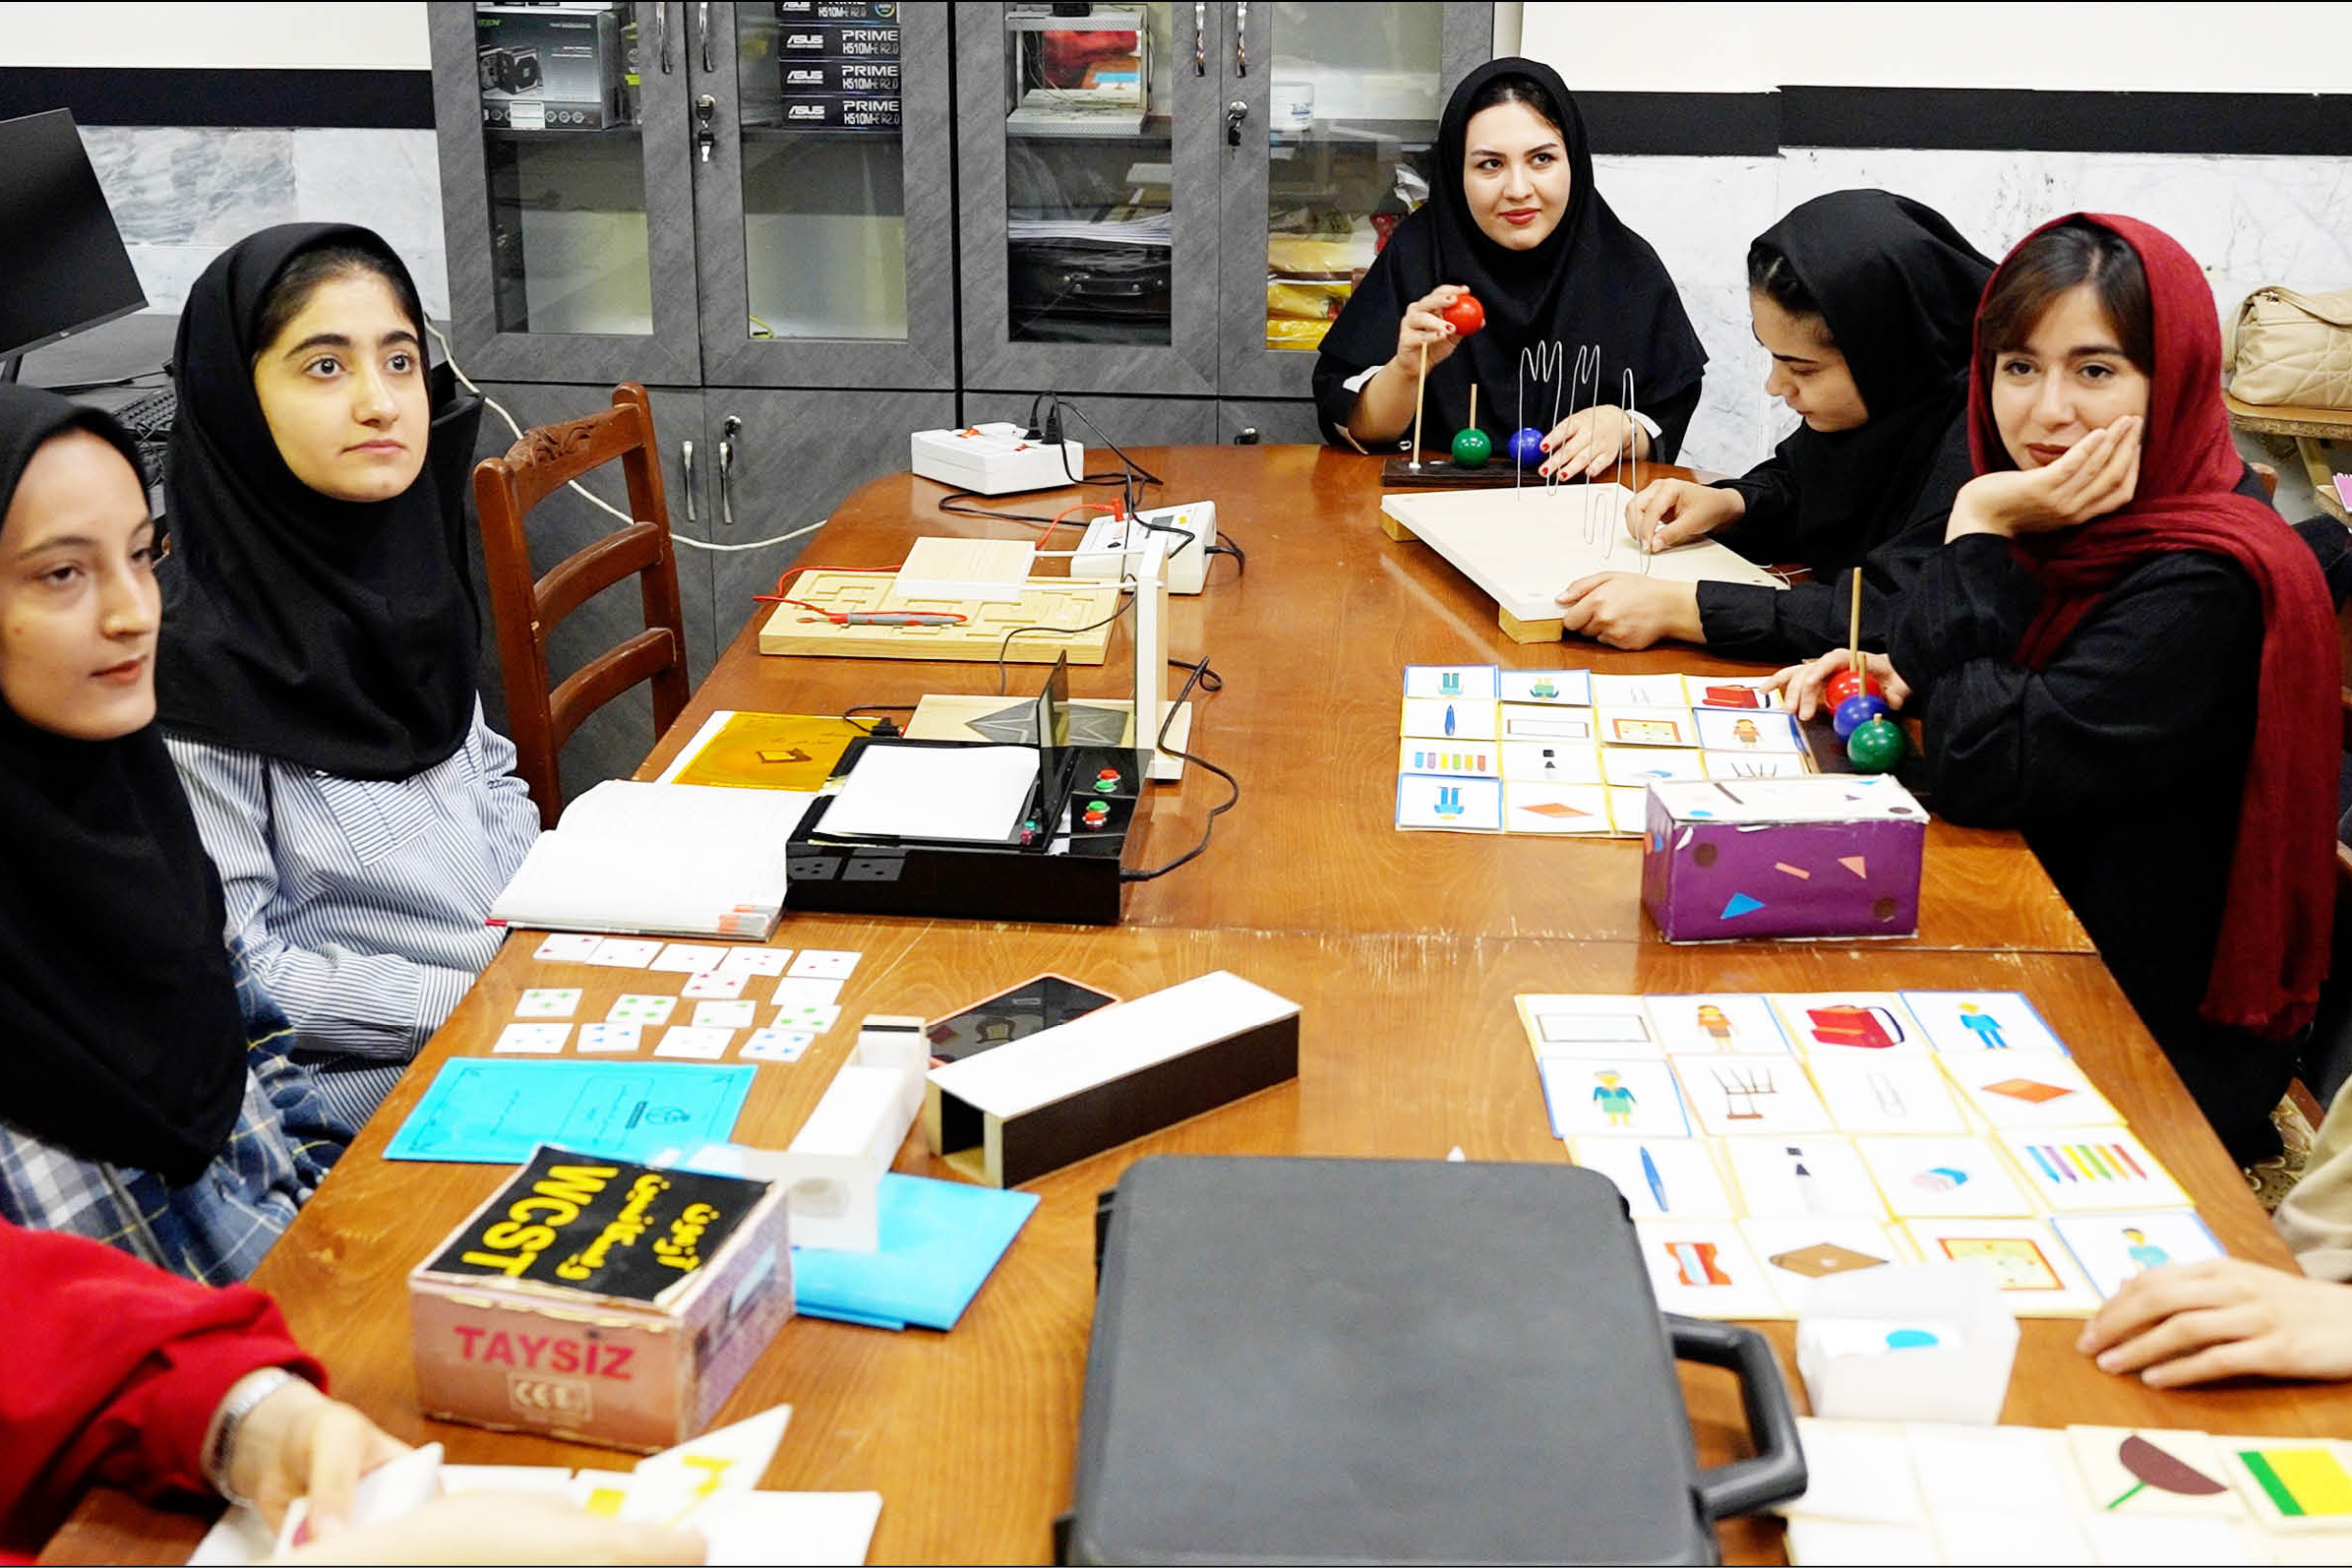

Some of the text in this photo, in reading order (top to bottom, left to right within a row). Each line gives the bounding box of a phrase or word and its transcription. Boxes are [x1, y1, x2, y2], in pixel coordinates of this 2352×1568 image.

[787, 34, 824, 44] ASUS
[841, 30, 899, 41] PRIME
[787, 70, 824, 80] ASUS
[841, 65, 899, 77] PRIME
[788, 105, 825, 115] ASUS
[843, 100, 900, 112] PRIME
[460, 1165, 620, 1279] WCST
[653, 1203, 720, 1274] آزمون
